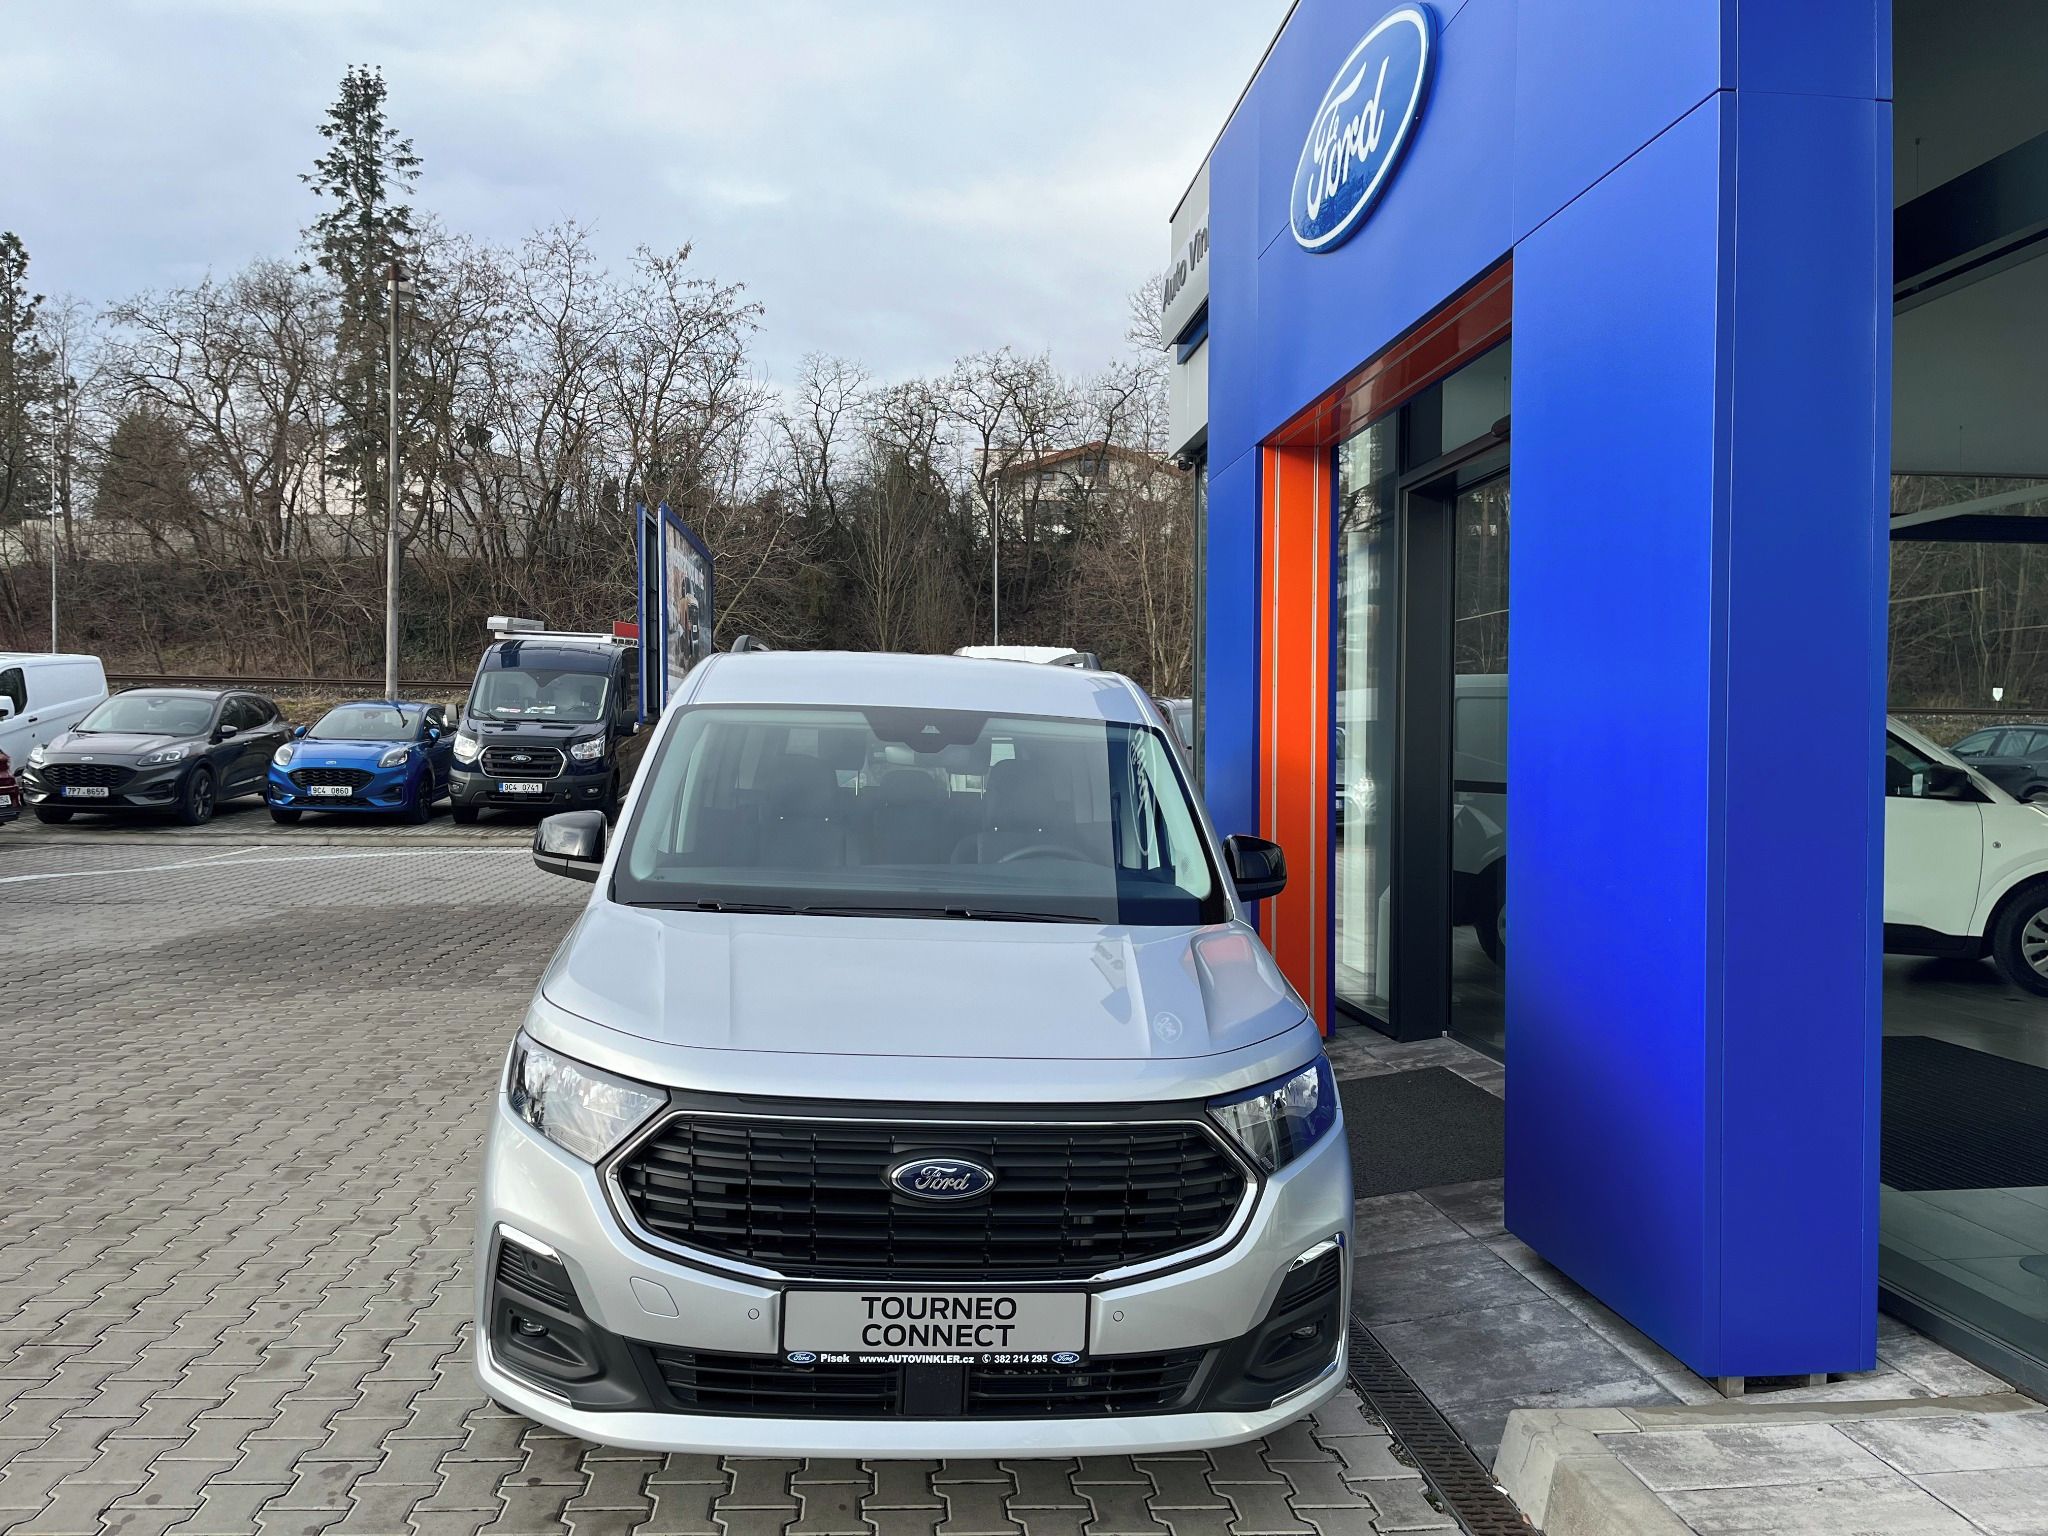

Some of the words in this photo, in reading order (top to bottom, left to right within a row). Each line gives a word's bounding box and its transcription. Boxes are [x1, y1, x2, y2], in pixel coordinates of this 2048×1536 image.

[1307, 55, 1390, 221] Ford
[1163, 260, 1187, 312] Auto
[1189, 218, 1209, 271] Vin
[67, 787, 80, 795] 7P7
[87, 787, 106, 796] 8655
[330, 787, 349, 795] 0860
[914, 1165, 971, 1190] Ford
[861, 1296, 1017, 1320] TOURNEO
[861, 1323, 1016, 1347] CONNECT
[820, 1353, 850, 1363] Písek
[859, 1354, 975, 1364] www.AUTOVINKLER.cz
[994, 1354, 1011, 1363] 382
[1012, 1354, 1029, 1363] 214
[1031, 1354, 1048, 1363] 295
